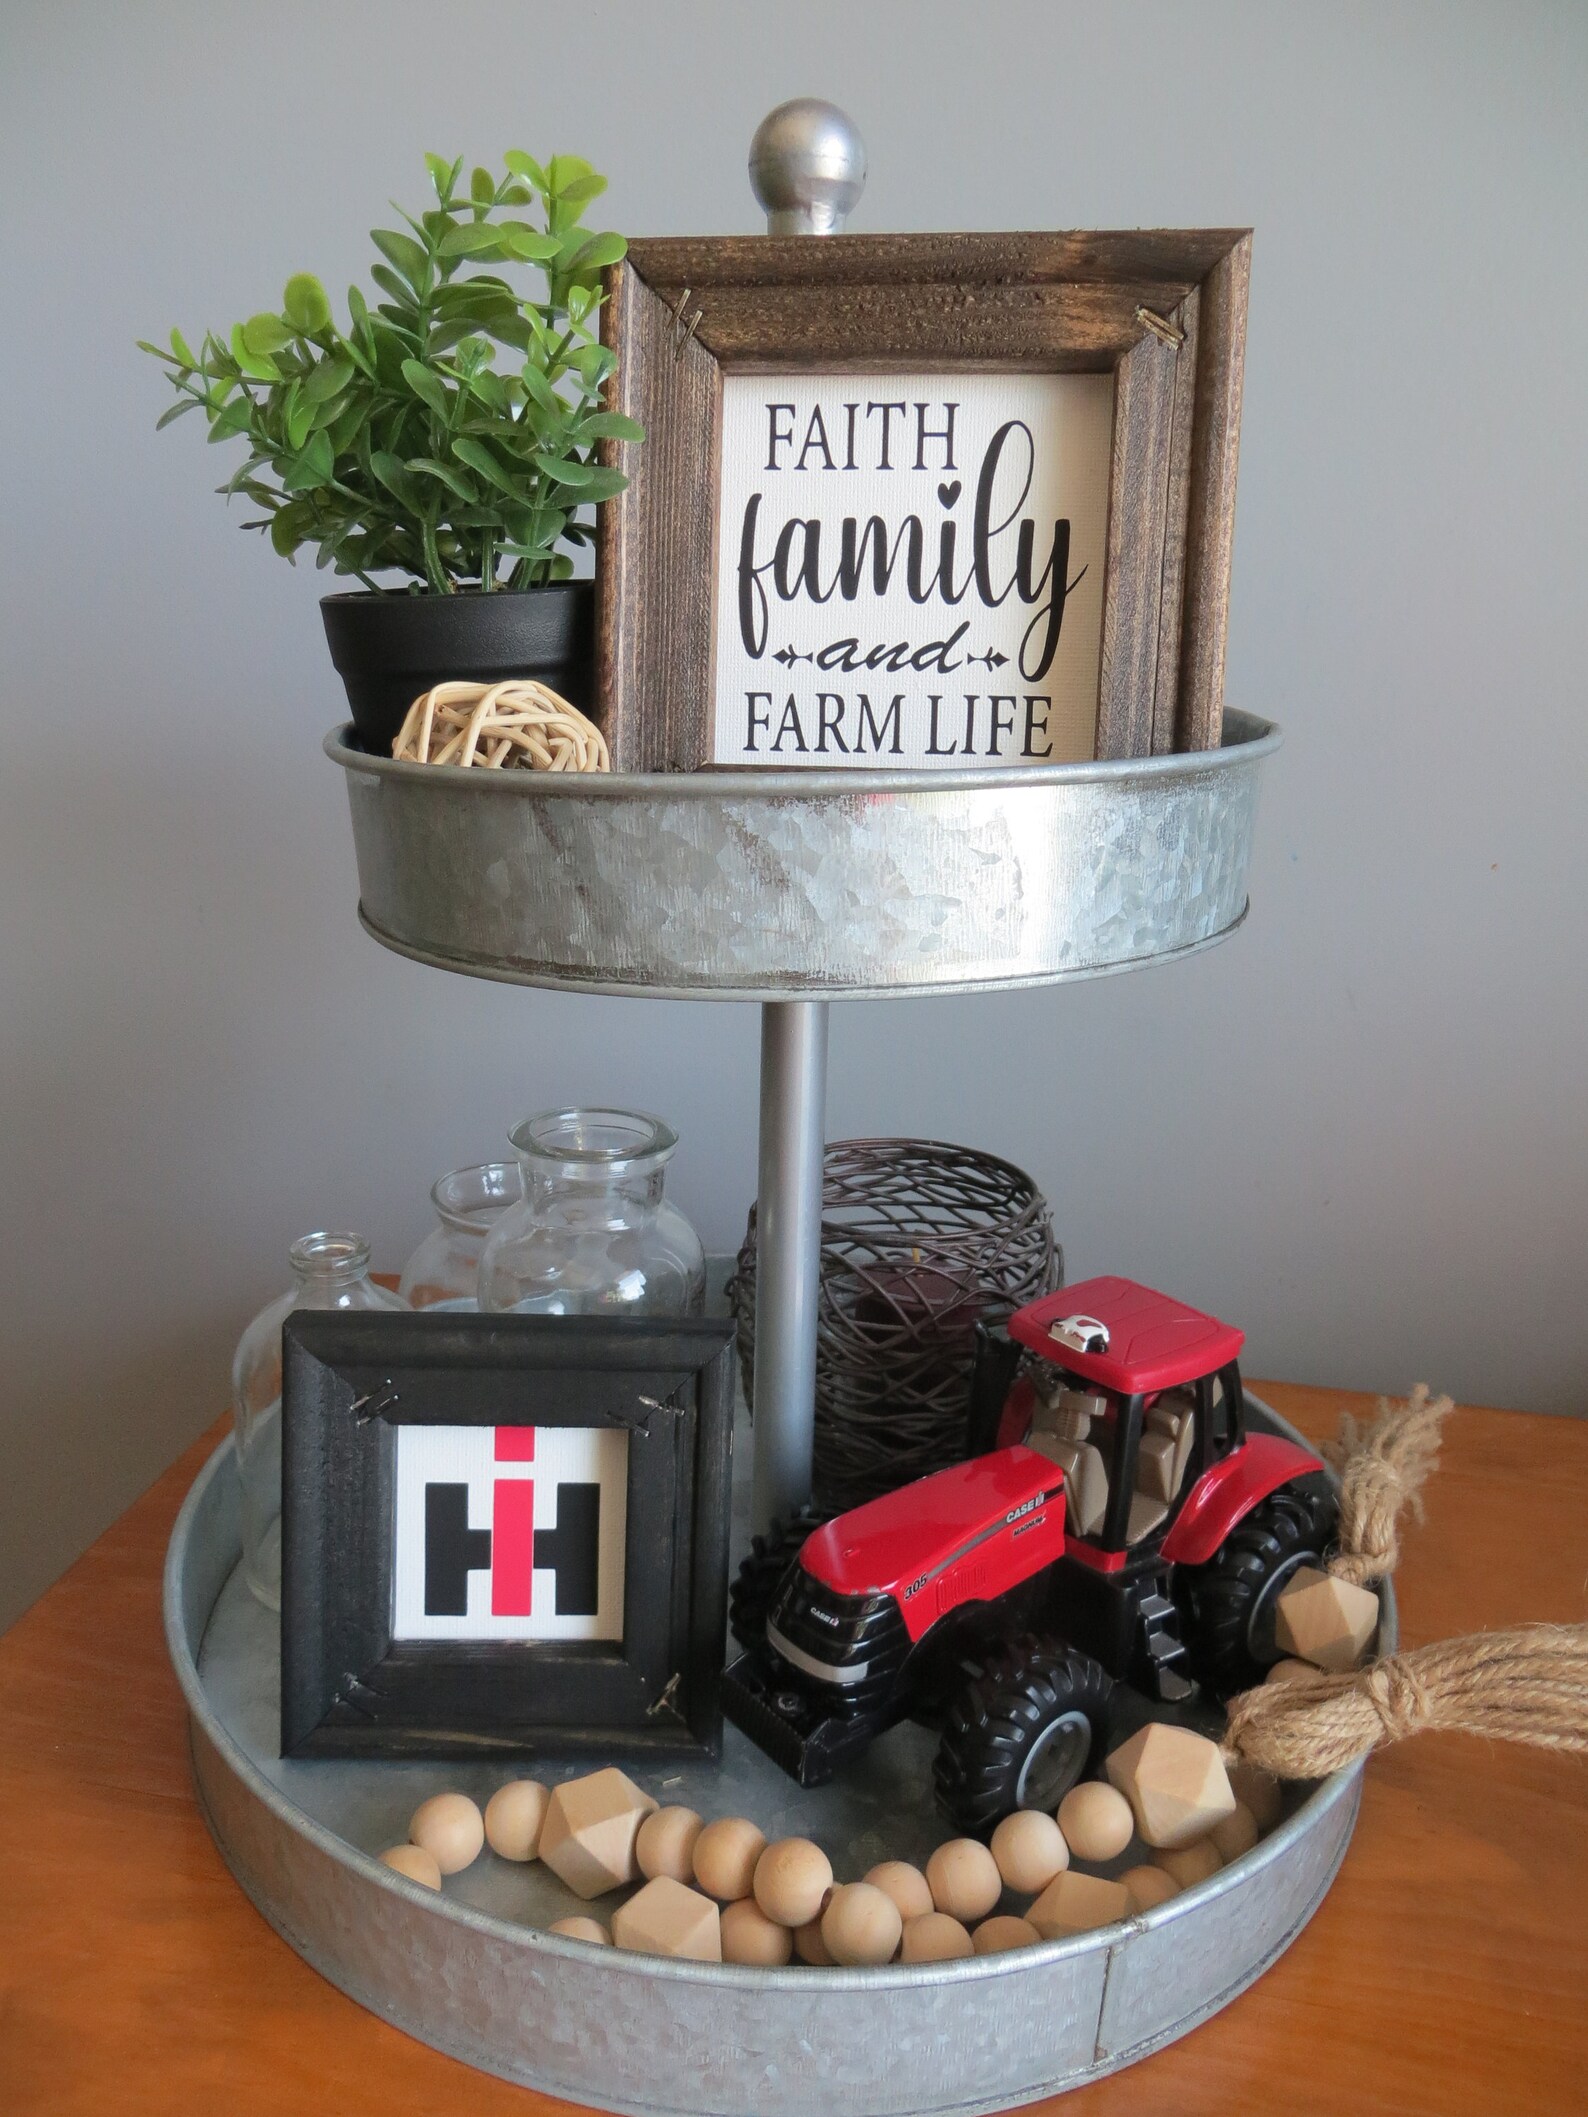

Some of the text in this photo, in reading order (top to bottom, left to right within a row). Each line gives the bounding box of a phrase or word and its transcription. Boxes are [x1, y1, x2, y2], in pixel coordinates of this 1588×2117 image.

[764, 402, 960, 471] FAITH
[738, 420, 1089, 682] family
[816, 621, 970, 673] and
[743, 692, 1054, 758] FARM LIFE
[1006, 1499, 1035, 1523] CASE
[904, 1573, 928, 1600] 305
